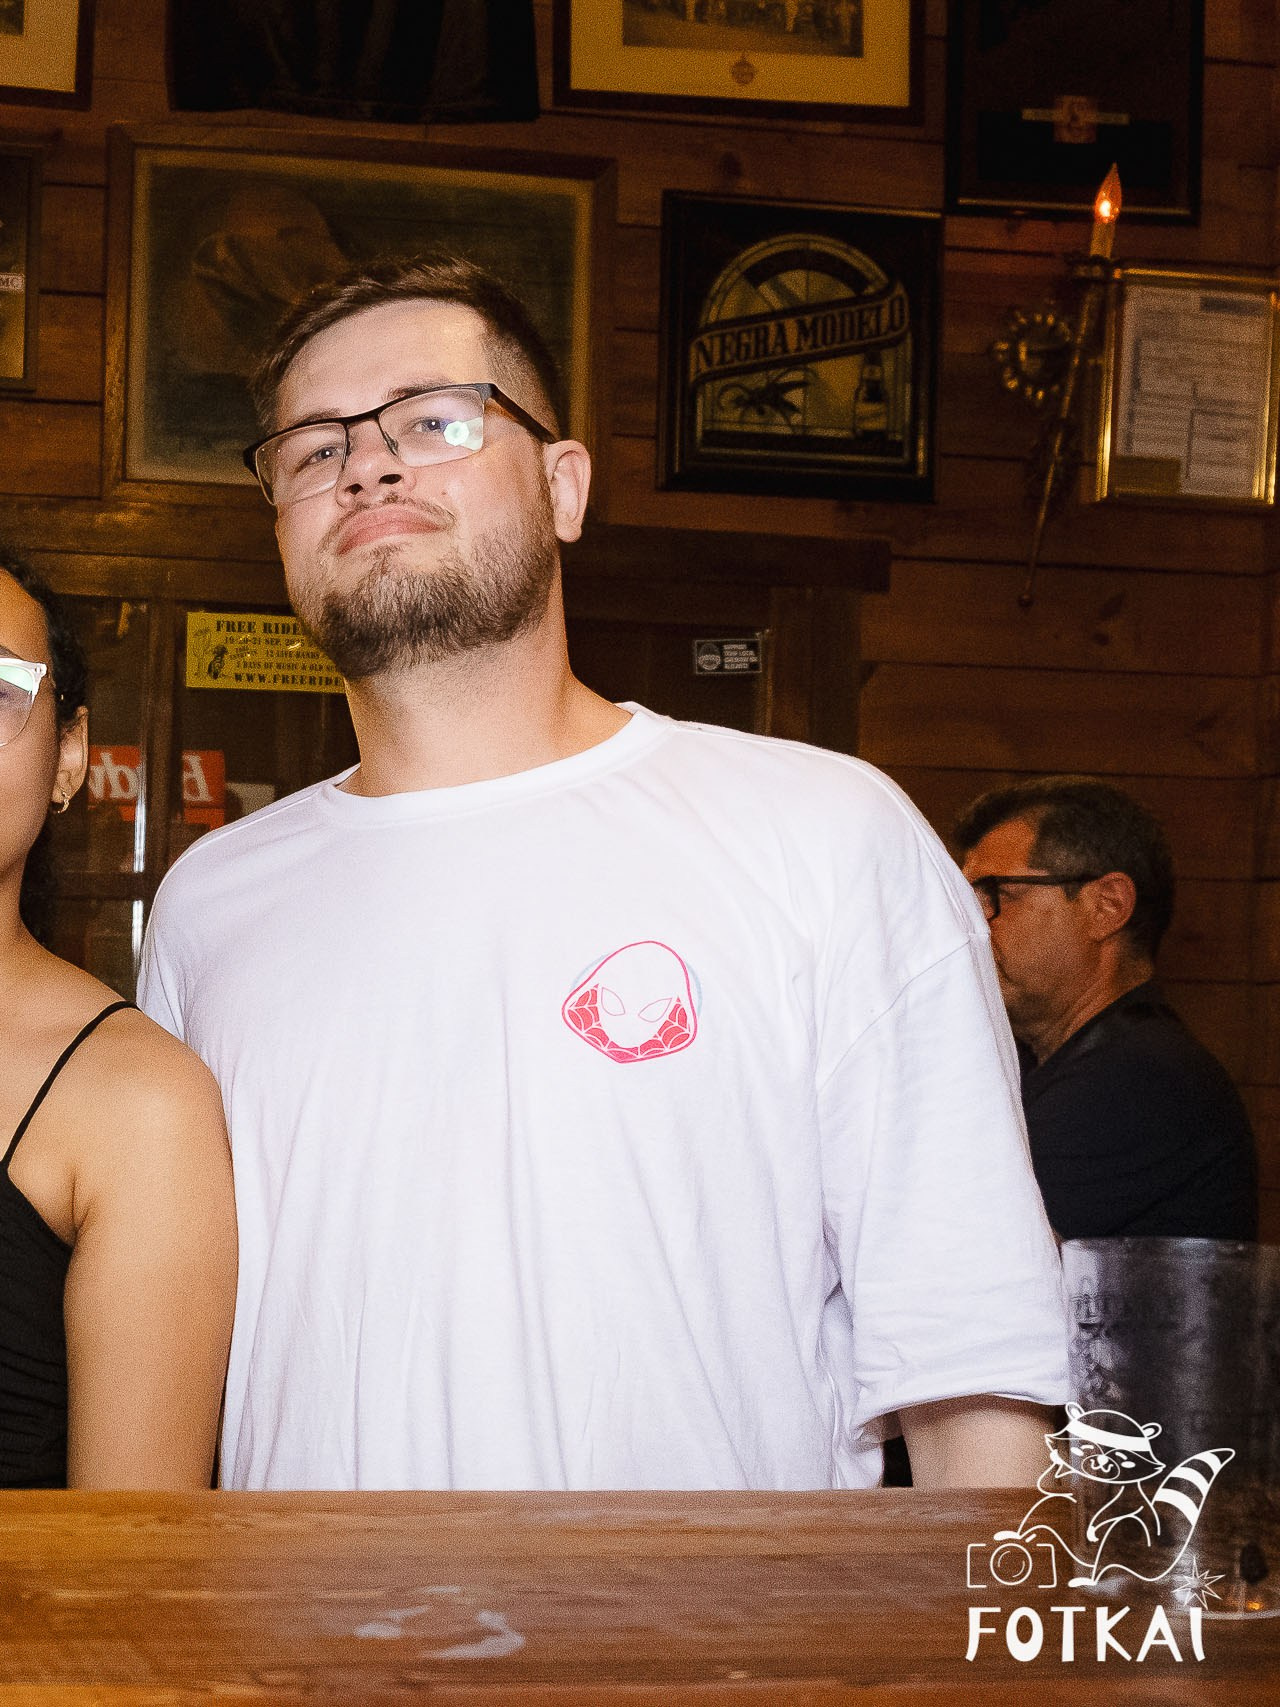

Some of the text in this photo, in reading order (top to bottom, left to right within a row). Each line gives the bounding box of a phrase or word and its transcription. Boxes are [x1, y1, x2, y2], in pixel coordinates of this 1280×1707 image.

[694, 296, 905, 373] NEGRA MODELO
[216, 620, 256, 634] FREE
